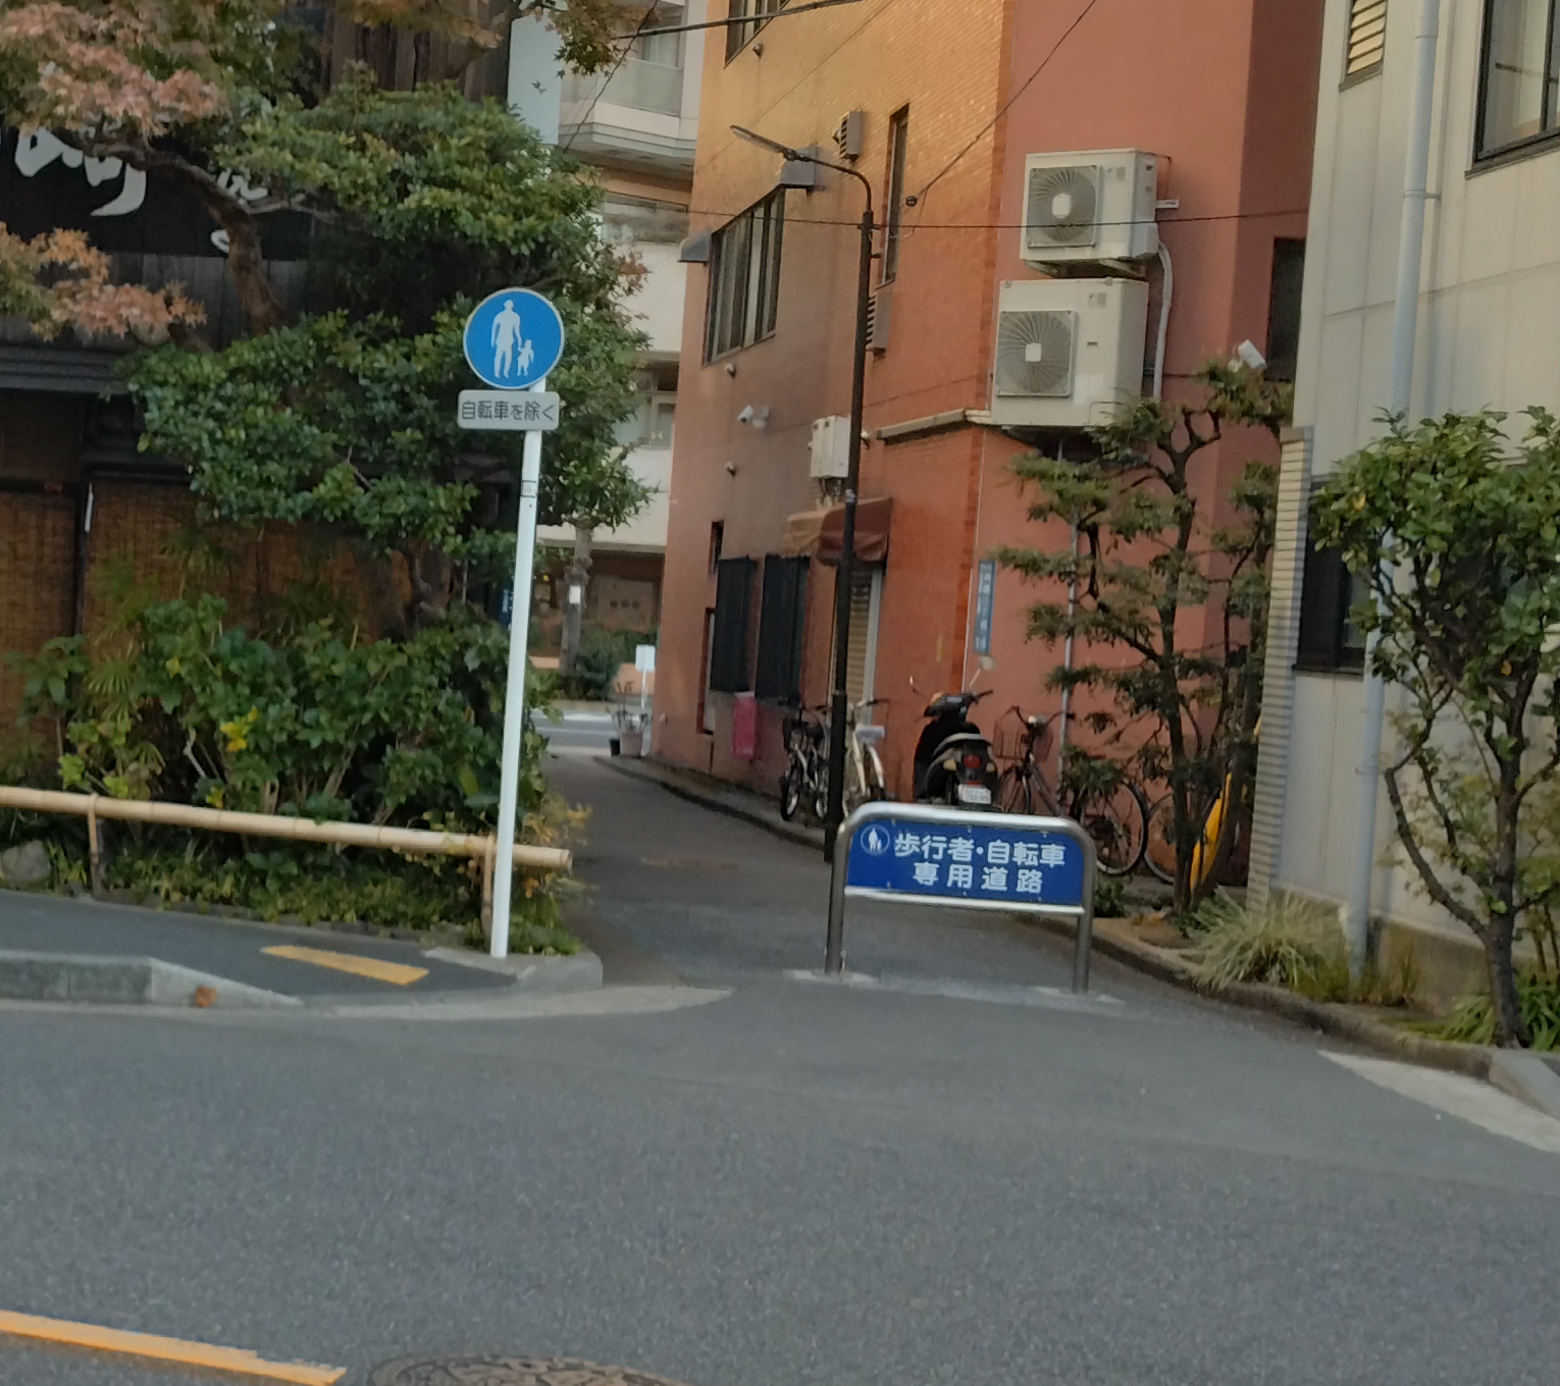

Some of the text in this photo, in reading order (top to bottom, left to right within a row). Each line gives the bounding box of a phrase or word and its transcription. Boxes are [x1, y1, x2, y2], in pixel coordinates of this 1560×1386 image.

[462, 400, 554, 421] 自転車を除く
[894, 832, 1067, 868] 歩行者・自転車
[913, 862, 1044, 894] 専用道路
